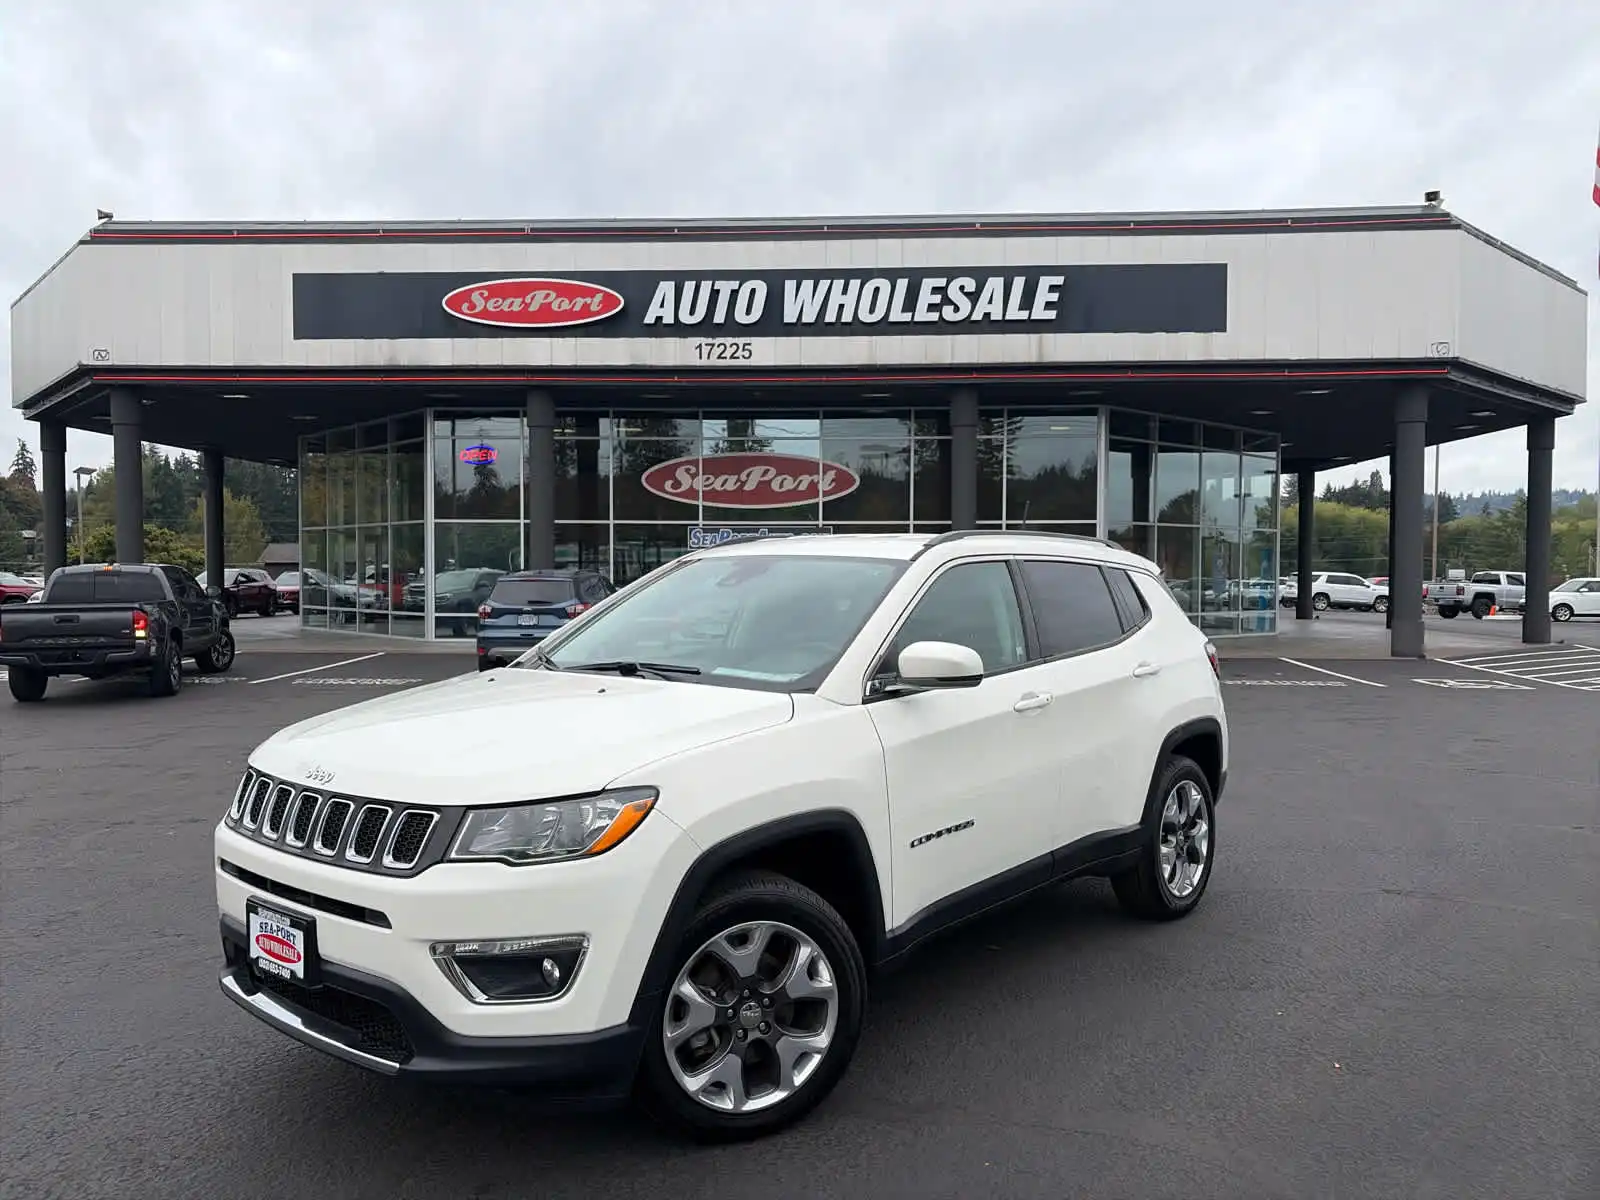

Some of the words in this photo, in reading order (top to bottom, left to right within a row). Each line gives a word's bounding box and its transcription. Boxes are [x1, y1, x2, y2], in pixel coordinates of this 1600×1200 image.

[461, 289, 604, 314] SeaPort
[643, 279, 768, 325] AUTO
[783, 276, 1065, 324] WHOLESALE
[695, 342, 753, 360] 17225
[459, 449, 498, 460] OPEN
[663, 464, 837, 493] SeaPort
[910, 819, 975, 849] COMPASS
[259, 921, 297, 946] SEA-PORT
